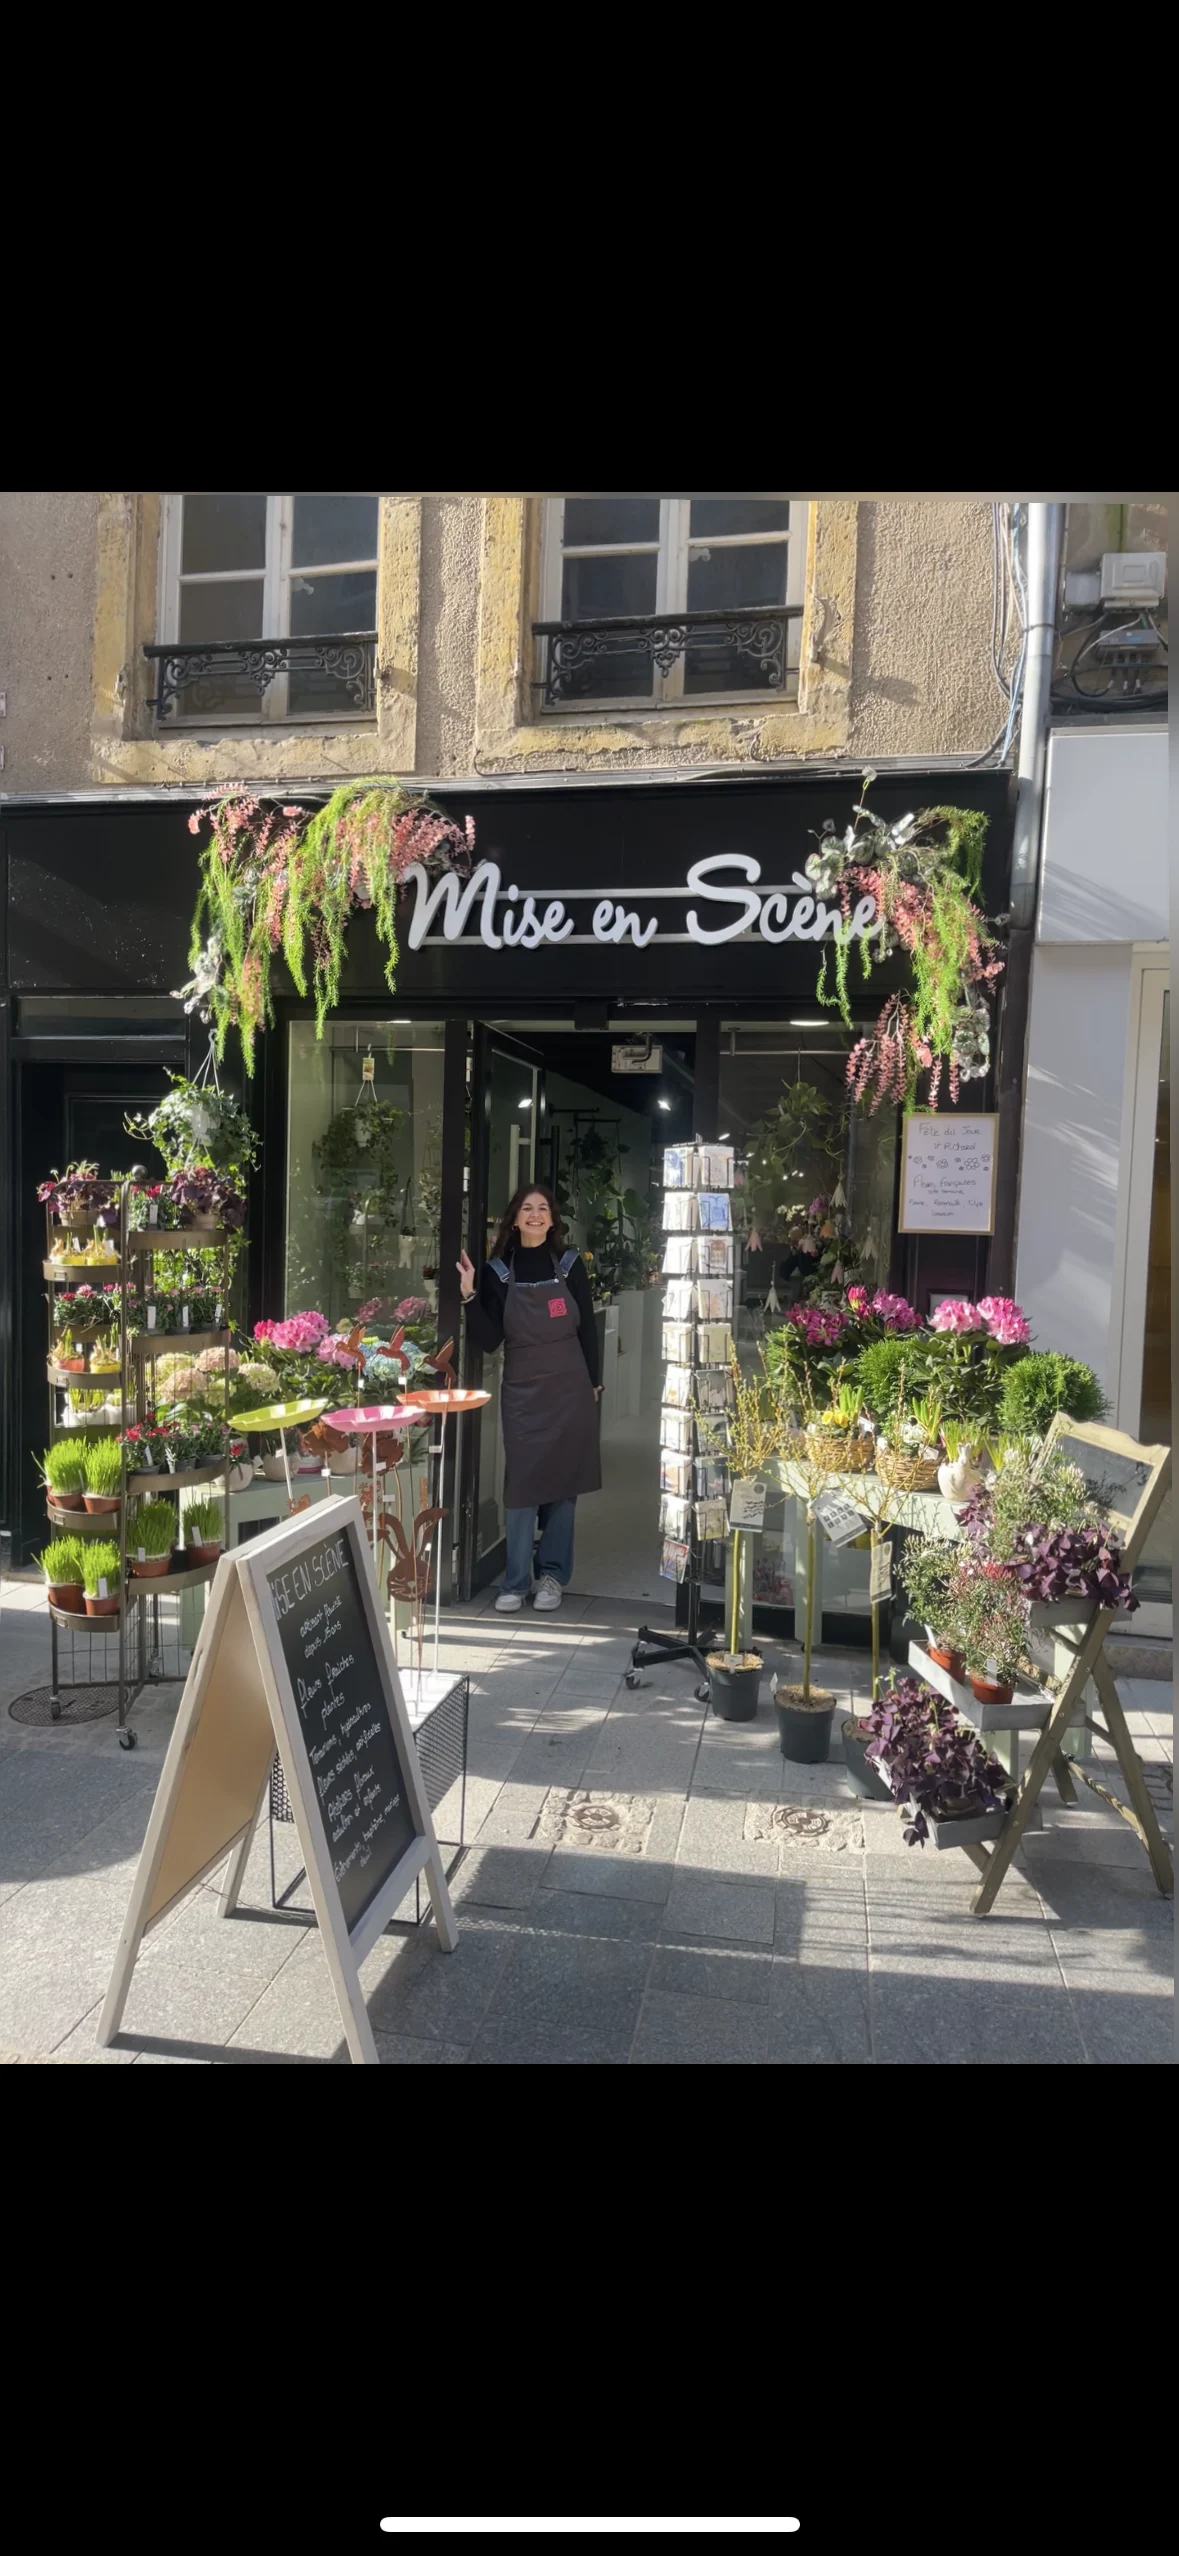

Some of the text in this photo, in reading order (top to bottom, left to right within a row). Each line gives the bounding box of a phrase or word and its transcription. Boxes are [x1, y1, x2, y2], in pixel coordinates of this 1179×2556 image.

[402, 853, 886, 950] Mise en Scène
[944, 1127, 956, 1136] du
[292, 1561, 312, 1600] EN
[312, 1538, 349, 1587] SCÈNE
